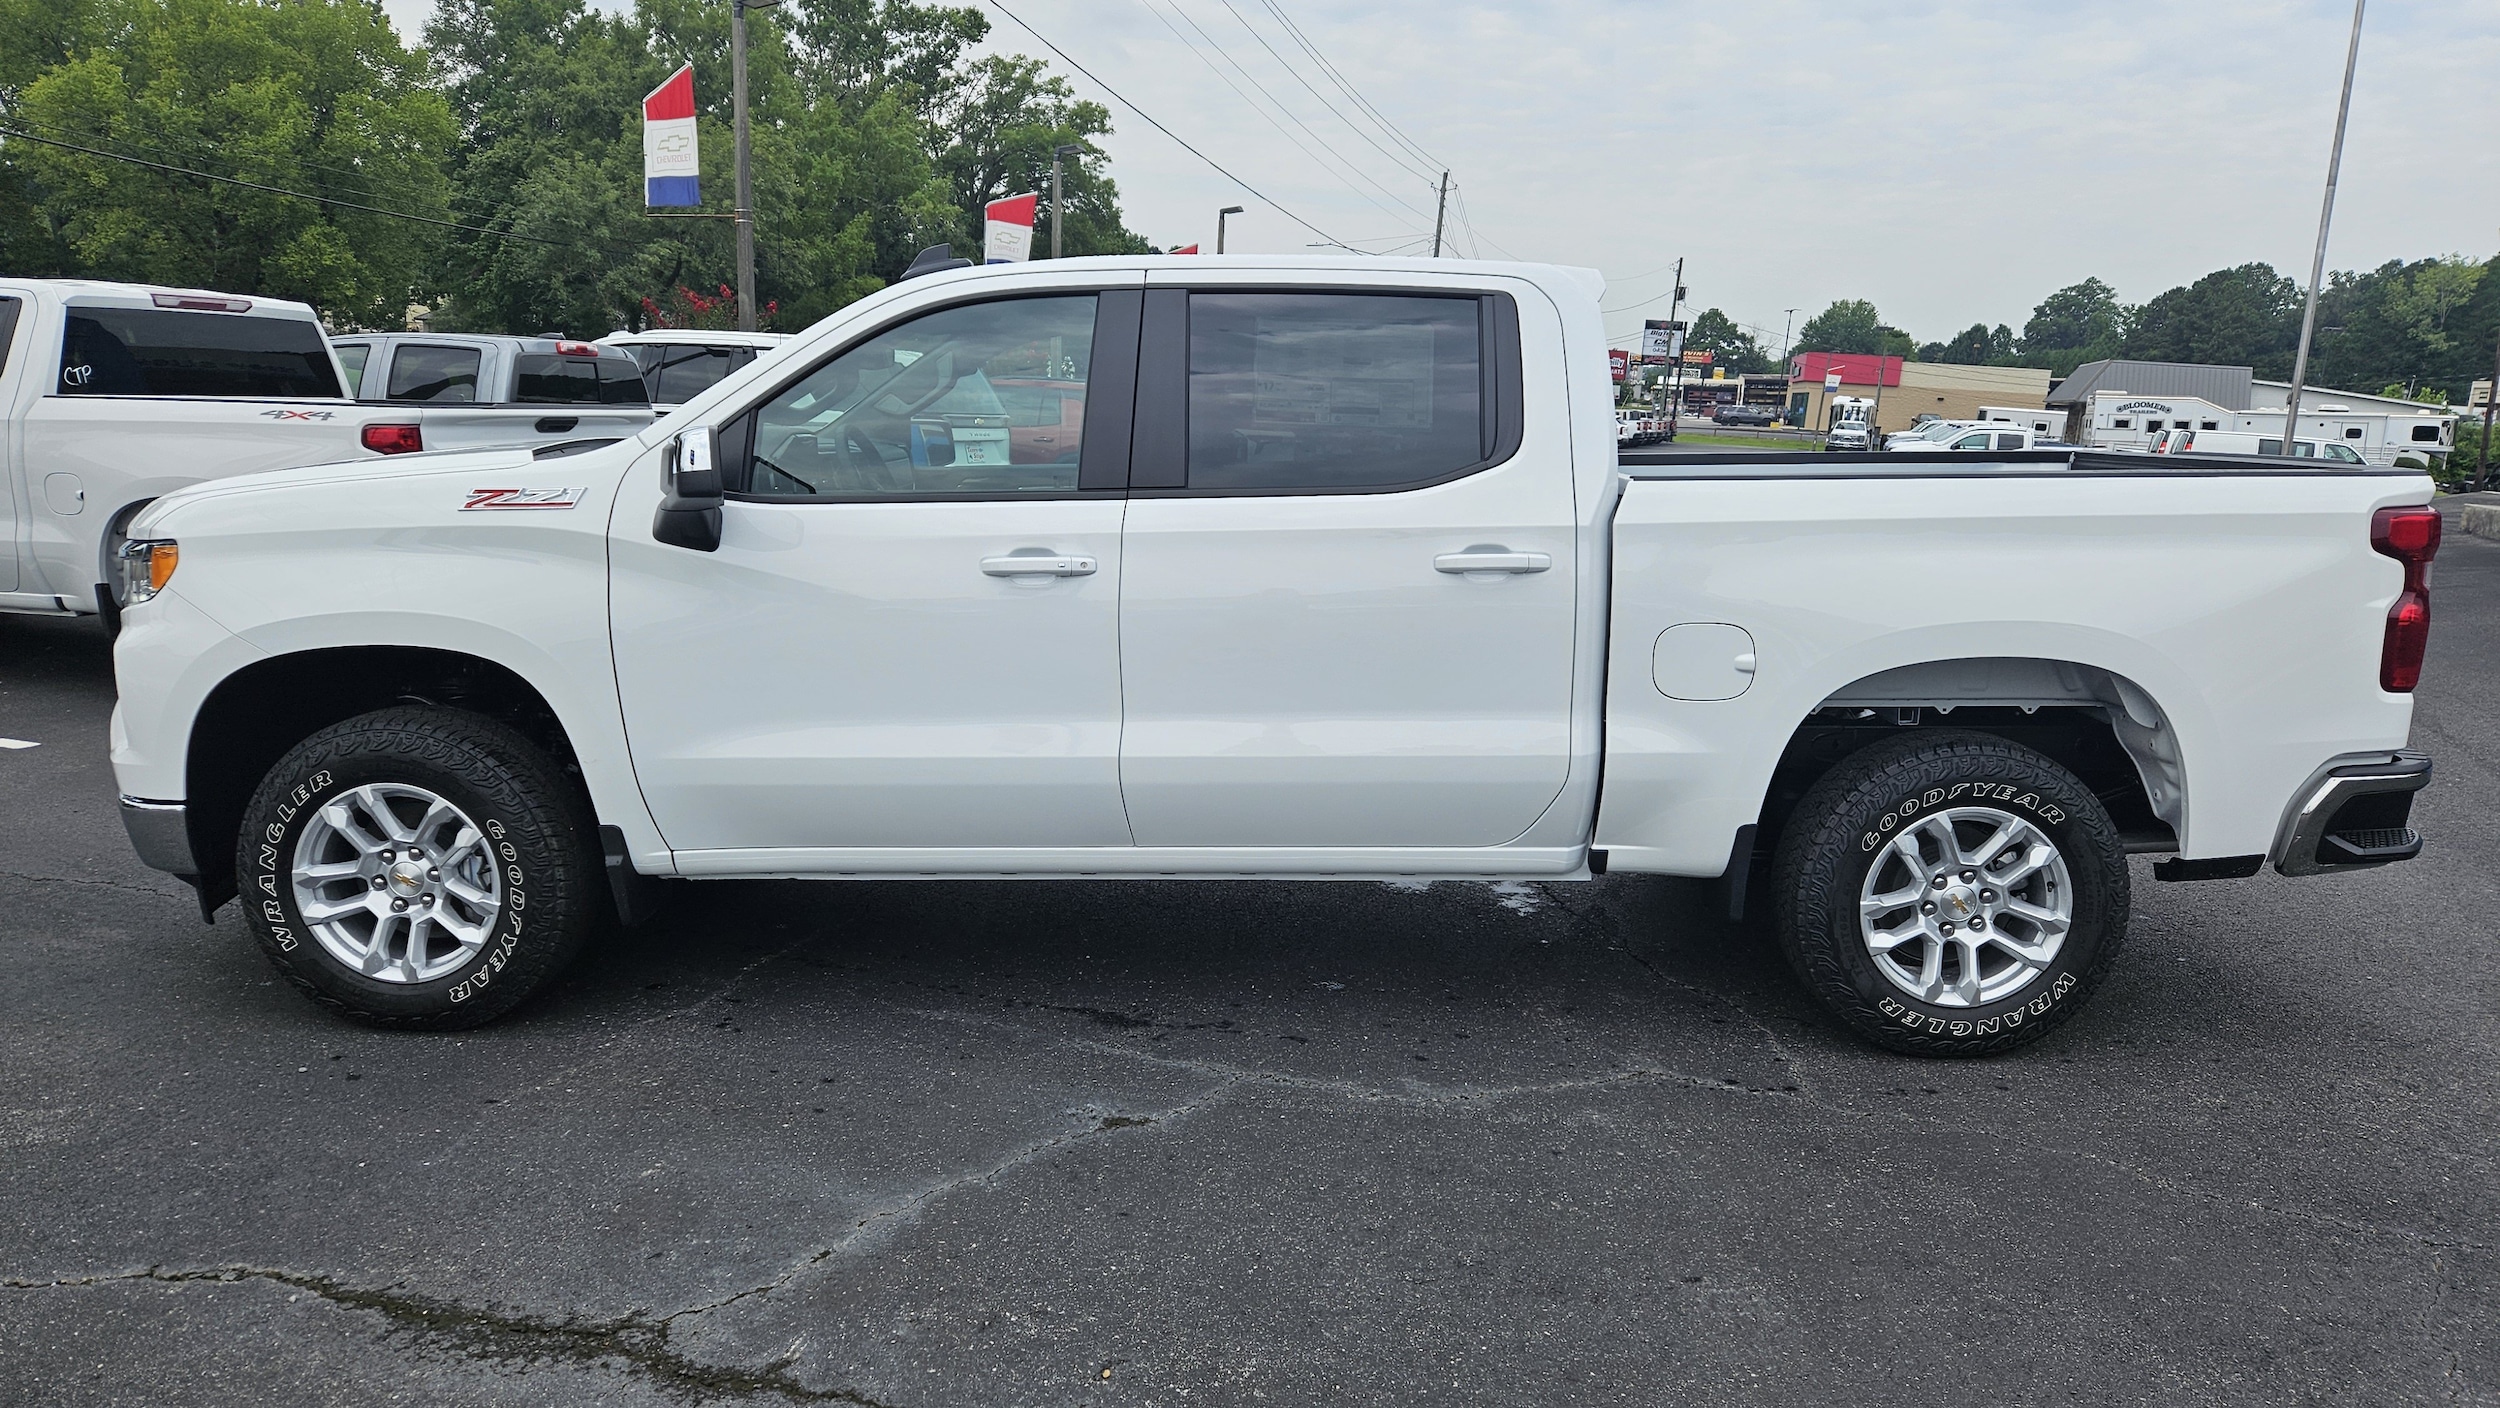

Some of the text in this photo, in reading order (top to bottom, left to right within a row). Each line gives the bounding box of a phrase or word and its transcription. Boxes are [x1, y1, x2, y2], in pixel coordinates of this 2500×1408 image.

[656, 153, 692, 165] CHEVROLET
[64, 365, 92, 386] CTP
[2122, 401, 2166, 412] BLOOMER
[457, 487, 588, 512] Z71
[1861, 782, 2066, 851] GOODYEAR
[259, 770, 333, 952] WRANGLER
[449, 818, 525, 1003] GOODYEAR
[1879, 972, 2076, 1036] WRANGLER
